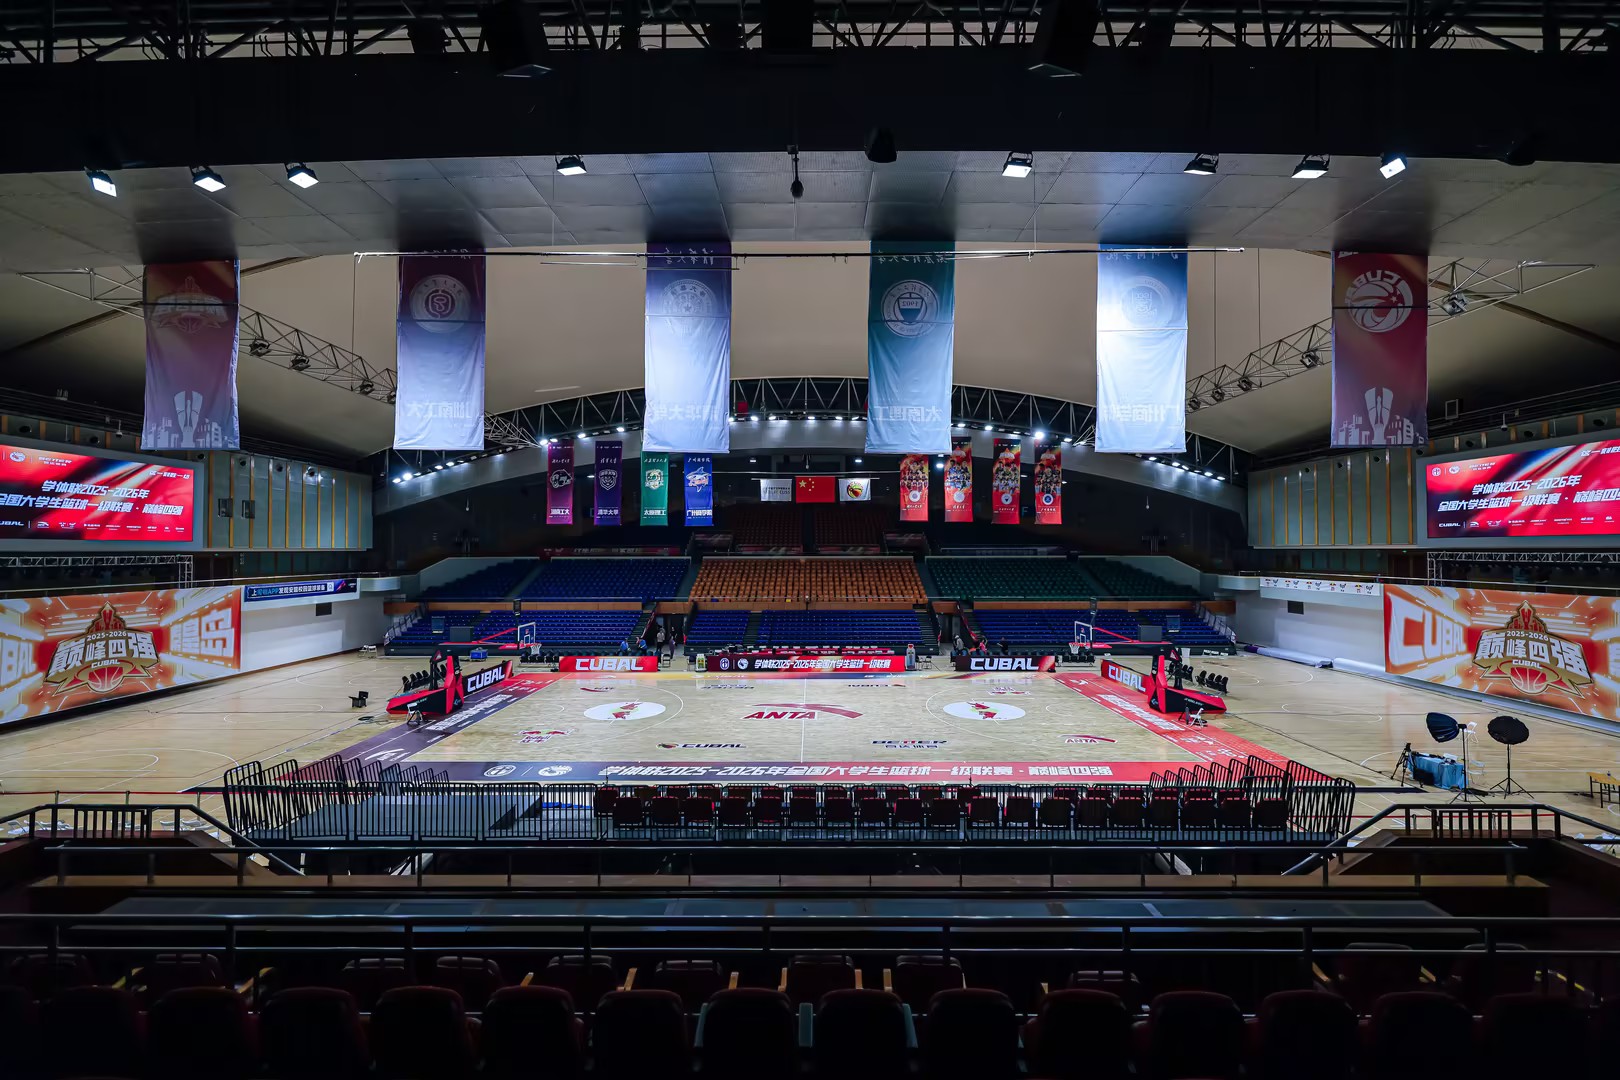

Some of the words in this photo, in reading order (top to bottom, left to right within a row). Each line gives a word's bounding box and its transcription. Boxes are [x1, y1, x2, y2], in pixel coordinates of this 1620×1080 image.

[41, 480, 151, 499] 学体联2025-2026年
[1471, 474, 1582, 496] 学体联2025-2026年
[87, 630, 128, 641] 2025-2026
[1387, 592, 1467, 666] CUBAL
[1506, 630, 1550, 642] 2025-2026
[48, 632, 158, 678] 巅峰四强
[1475, 631, 1592, 680] 巅峰四强
[91, 659, 121, 669] CUBAL
[575, 657, 644, 671] CUBAL
[754, 658, 891, 669] 学体联2025-2026年全国大学生篮球一级联赛
[970, 657, 1040, 671] CUBAL
[1512, 659, 1544, 670] CUBAL
[467, 667, 506, 693] CUBAL
[1107, 664, 1147, 692] CUBAL
[742, 711, 816, 720] ANTA
[598, 764, 1113, 777] 学体联2025-2026年全国大学生篮球一级联赛·巅峰四强
